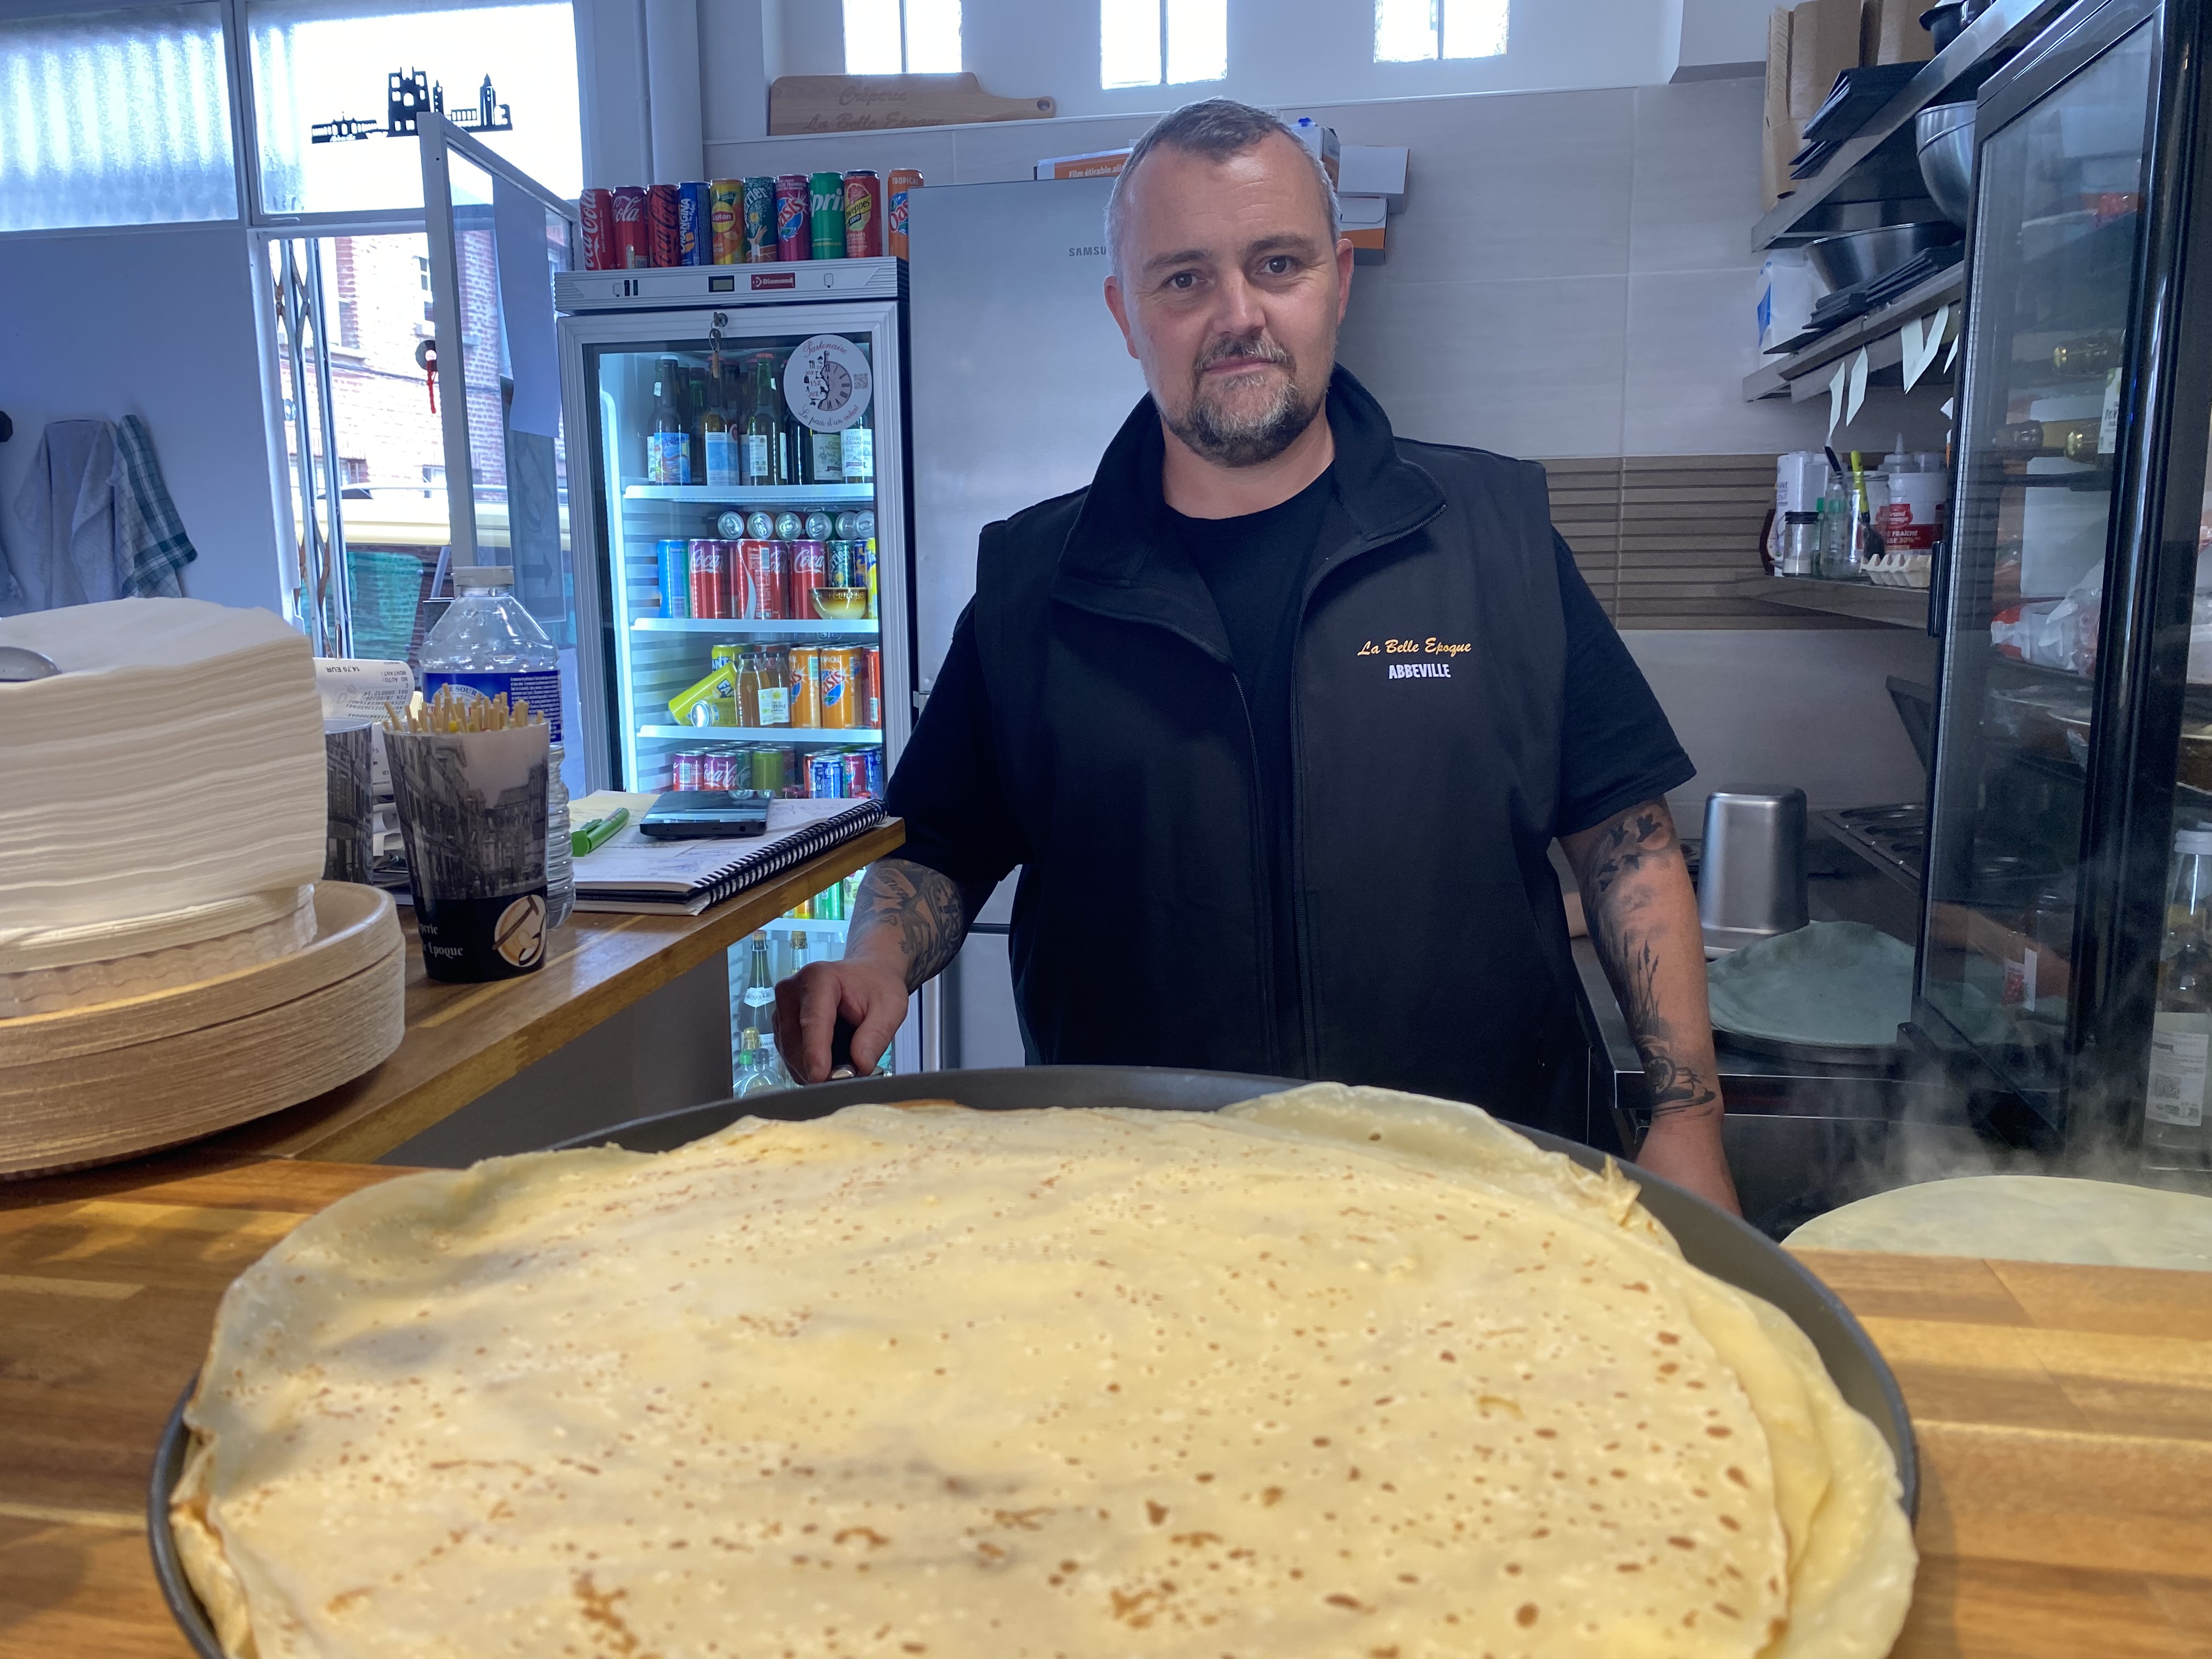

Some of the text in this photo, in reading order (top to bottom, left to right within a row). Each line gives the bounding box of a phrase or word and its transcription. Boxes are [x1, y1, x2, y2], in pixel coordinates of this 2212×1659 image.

[836, 112, 877, 129] Belle
[1069, 170, 1084, 178] Film
[1085, 165, 1111, 176] étirable
[891, 176, 920, 185] TROPICAL
[810, 188, 844, 218] pri
[712, 213, 732, 222] Lipton
[778, 199, 804, 229] asis
[1069, 245, 1107, 257] SAMSU
[803, 340, 848, 358] Partenaire
[1357, 637, 1471, 657] La Belle Epoque
[1389, 663, 1451, 680] ABBEVILLE
[822, 670, 845, 695] asis
[455, 686, 477, 697] SOUR
[427, 941, 464, 960] Epoque
